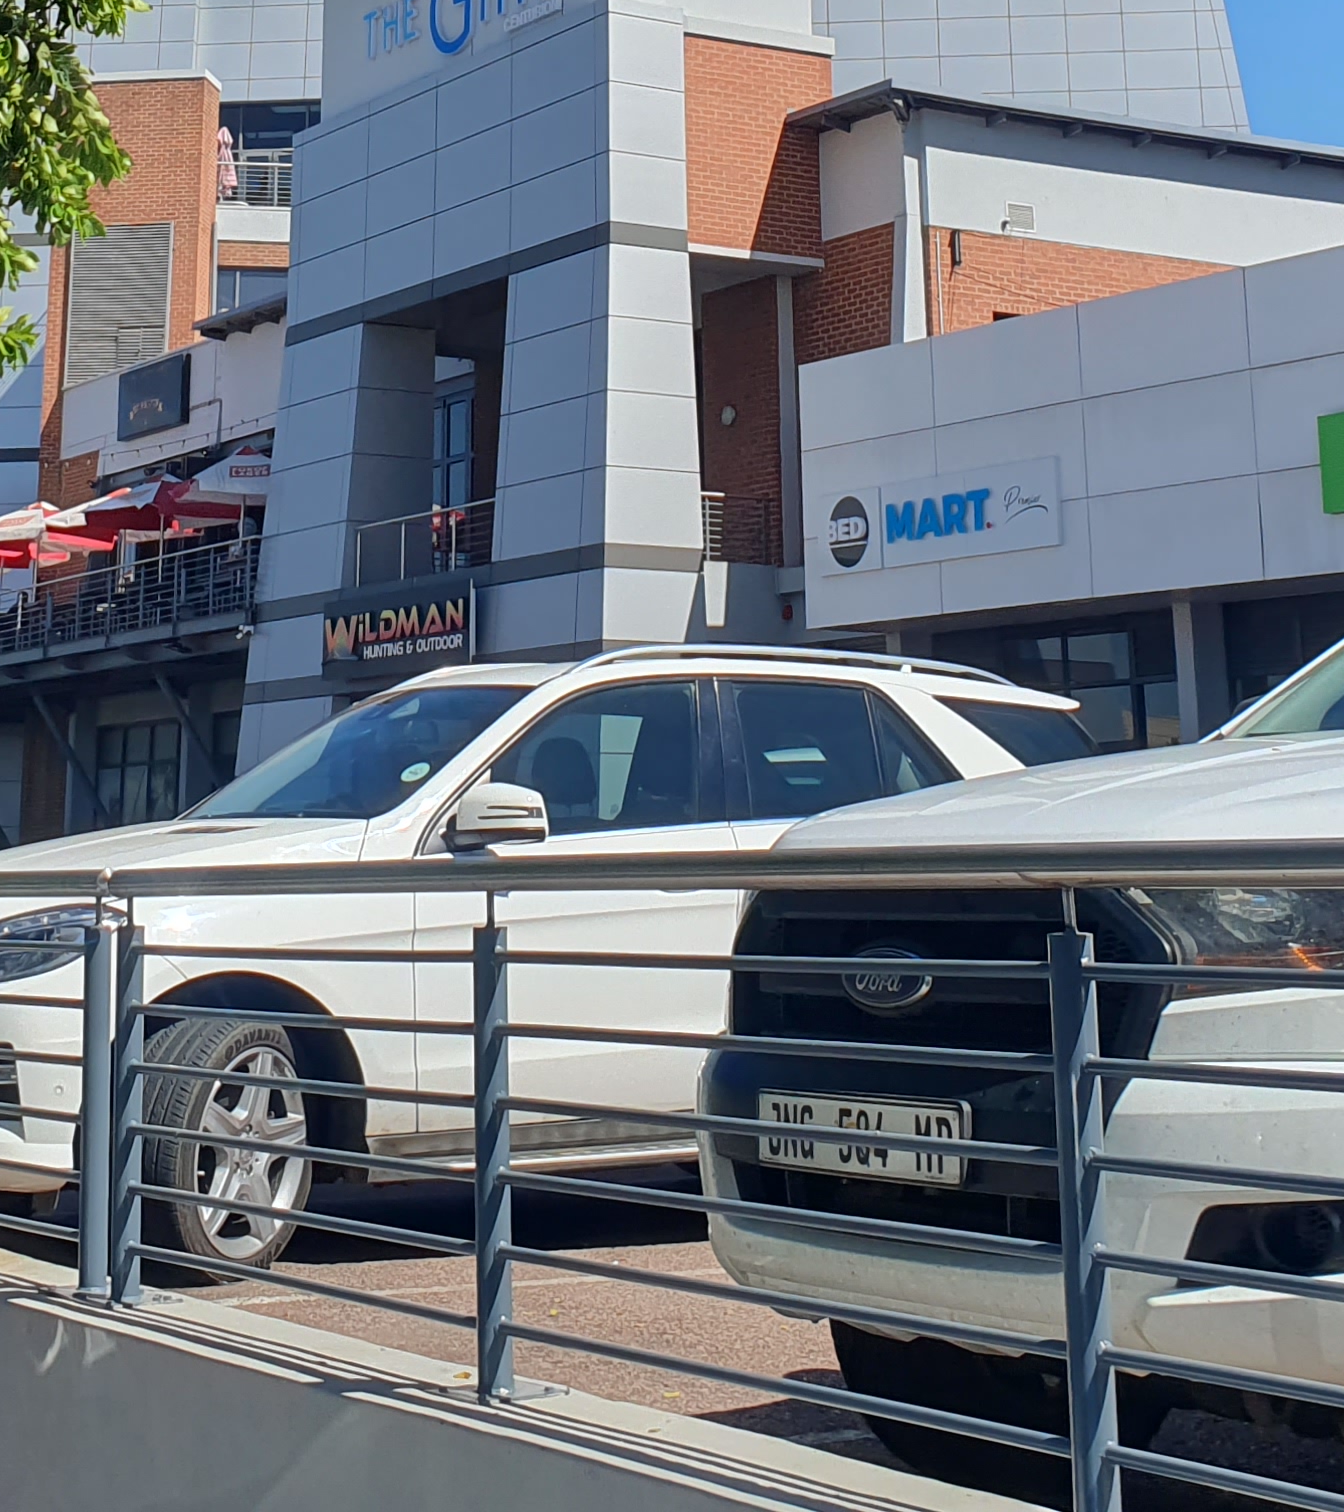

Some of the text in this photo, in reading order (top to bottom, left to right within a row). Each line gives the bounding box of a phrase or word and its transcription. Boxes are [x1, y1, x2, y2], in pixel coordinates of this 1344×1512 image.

[363, 633, 463, 660] HUNTING & OUTDOOR
[768, 1102, 815, 1160] JNG
[914, 1114, 953, 1175] MP
